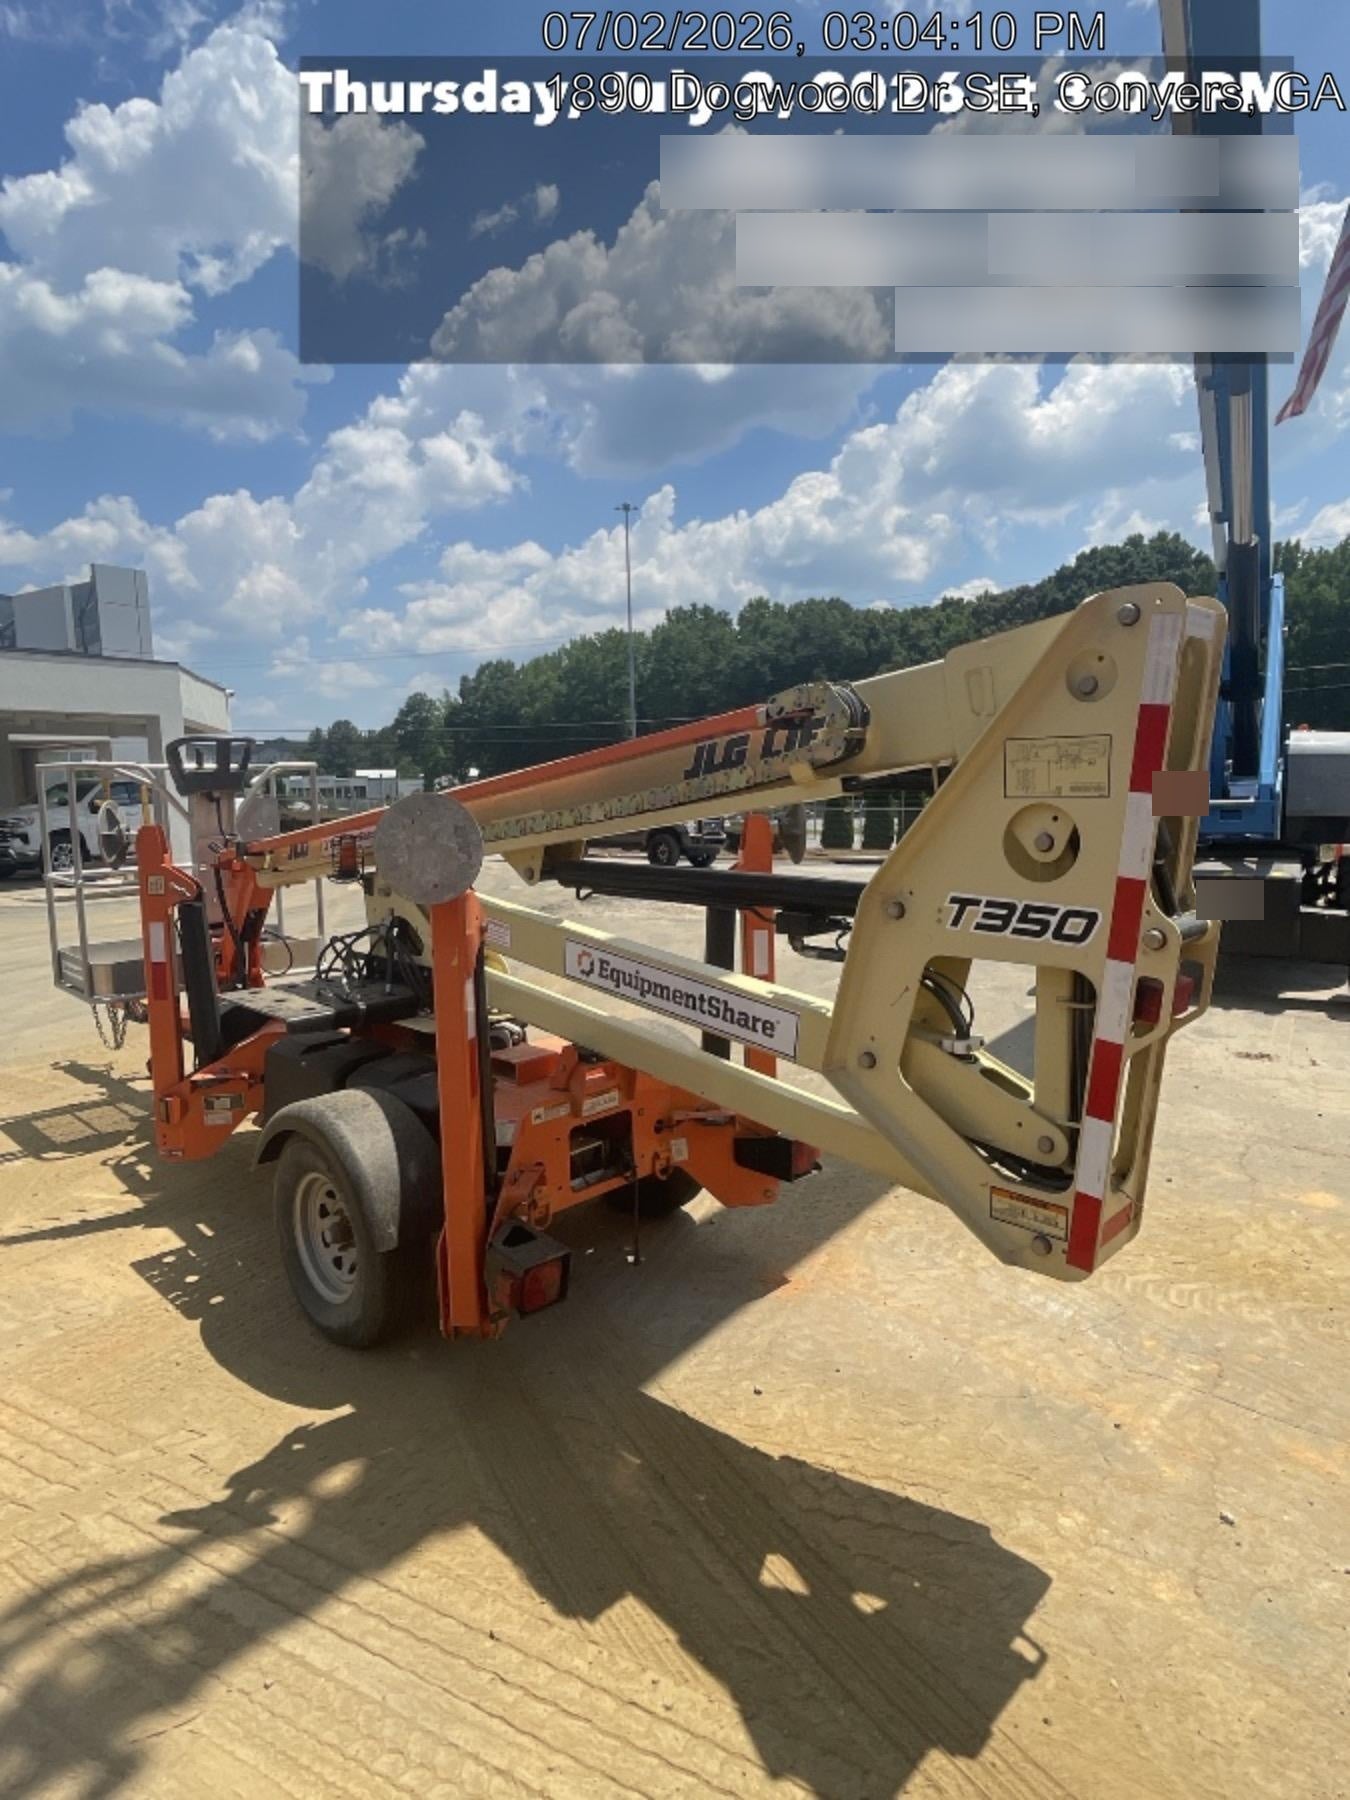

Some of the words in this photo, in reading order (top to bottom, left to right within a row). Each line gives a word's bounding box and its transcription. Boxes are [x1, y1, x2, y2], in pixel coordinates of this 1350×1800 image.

[684, 734, 751, 780] JLG
[949, 895, 1099, 945] T350
[597, 956, 777, 1039] EquipmentShare
